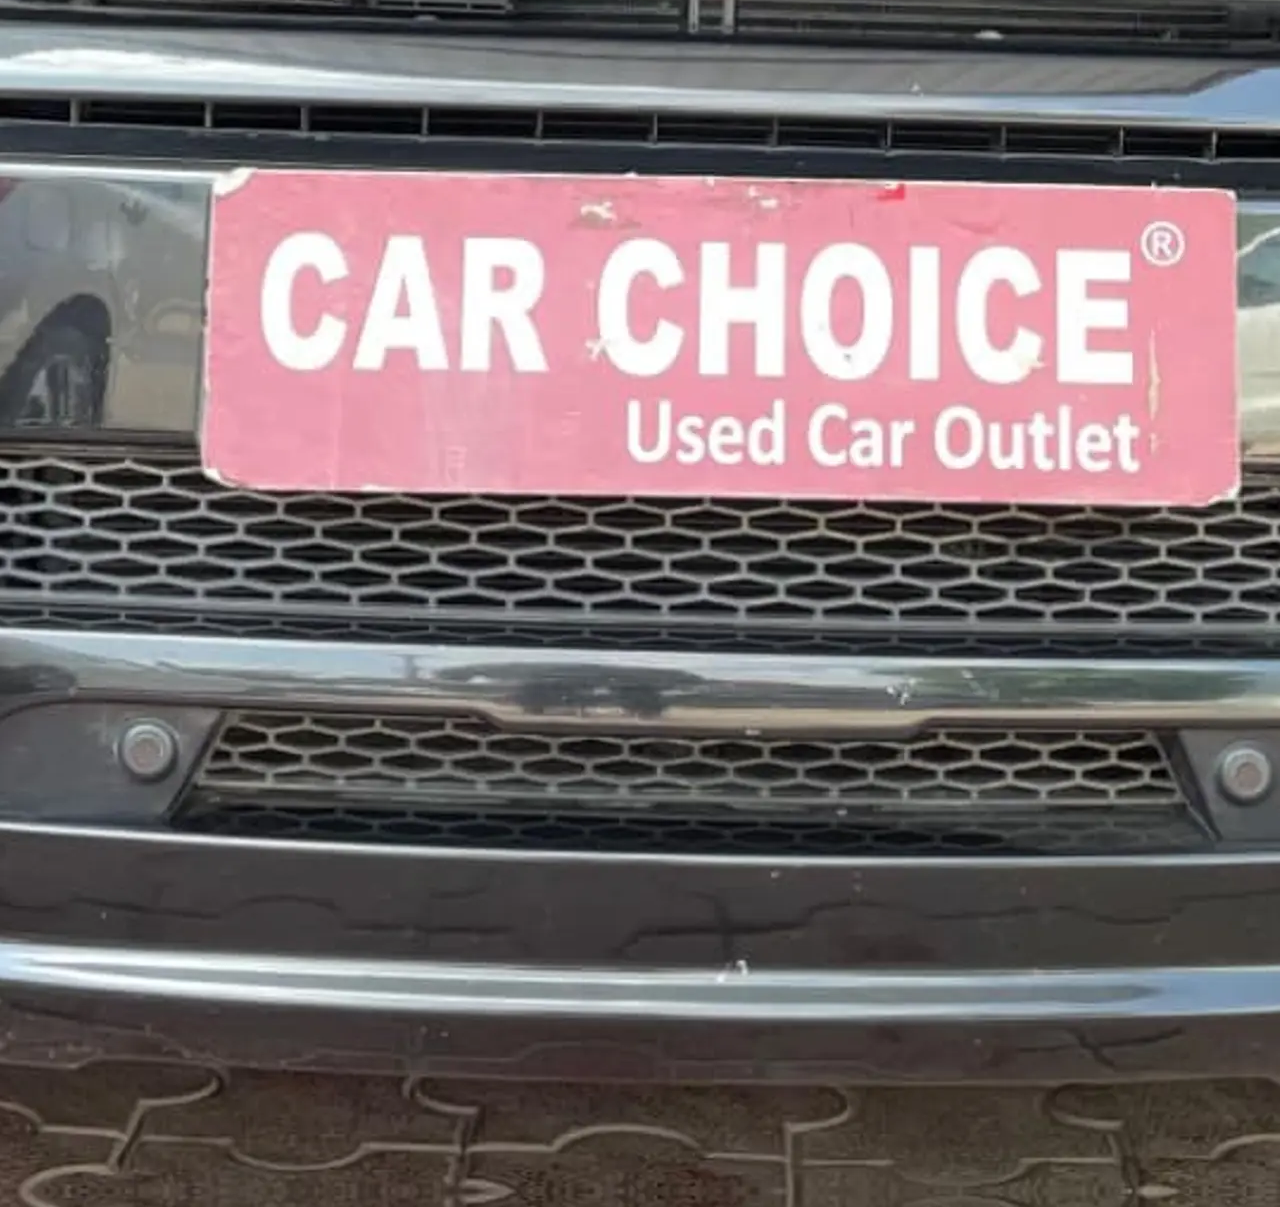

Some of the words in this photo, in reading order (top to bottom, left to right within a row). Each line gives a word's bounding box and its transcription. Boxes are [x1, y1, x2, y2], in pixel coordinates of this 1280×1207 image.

[260, 231, 550, 372] CAR
[626, 399, 786, 465] Used
[806, 404, 915, 468] Car
[933, 404, 1141, 473] Outlet
